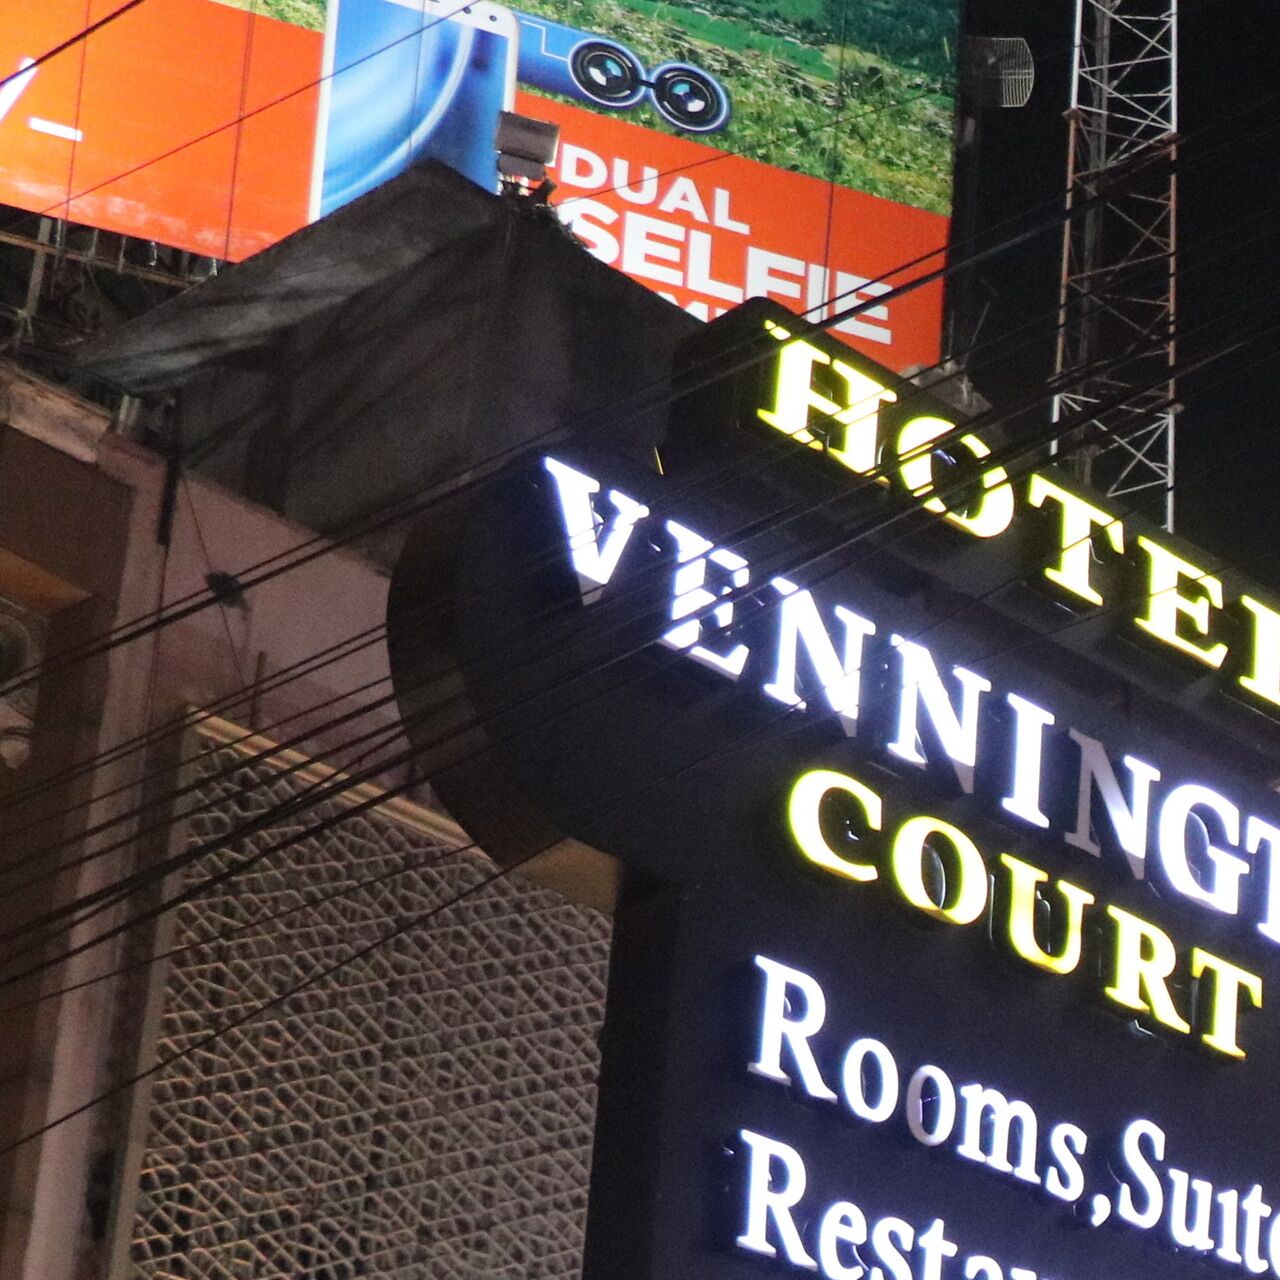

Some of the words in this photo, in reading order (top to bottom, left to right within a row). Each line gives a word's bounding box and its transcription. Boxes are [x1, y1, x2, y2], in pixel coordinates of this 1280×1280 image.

[560, 143, 750, 235] DUAL
[556, 196, 893, 345] SELFIE
[788, 769, 1264, 1061] COURT
